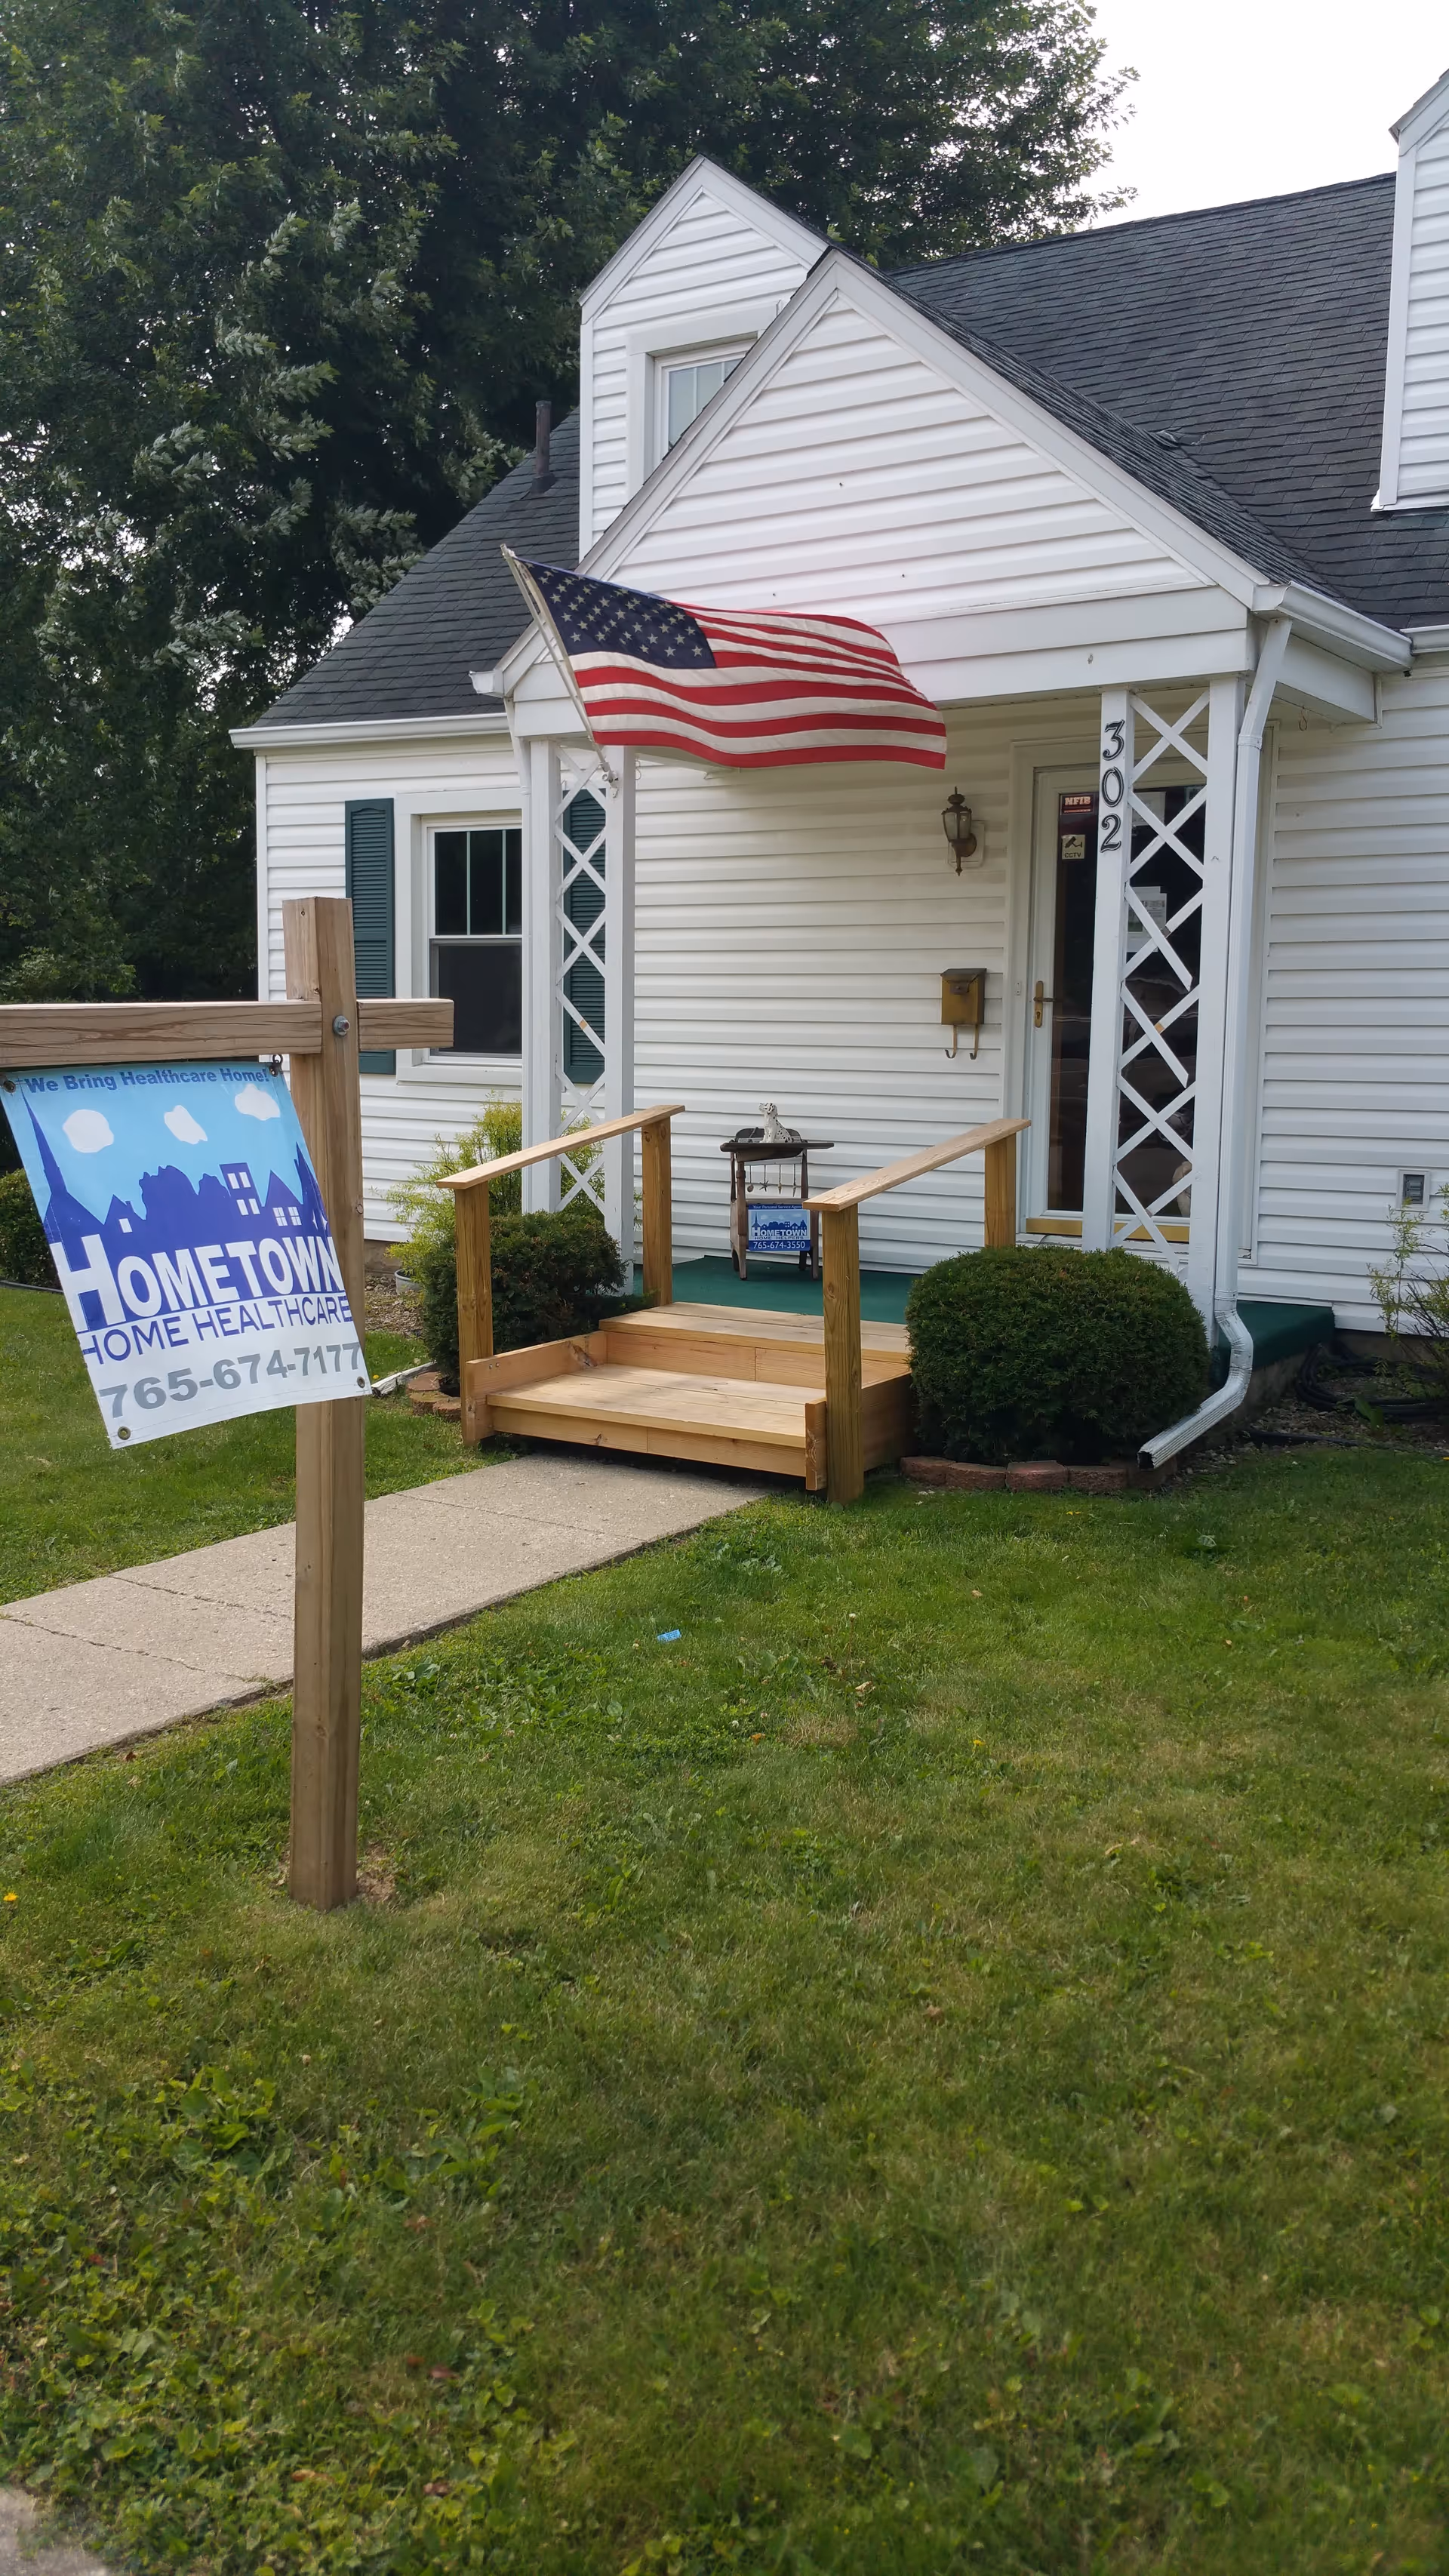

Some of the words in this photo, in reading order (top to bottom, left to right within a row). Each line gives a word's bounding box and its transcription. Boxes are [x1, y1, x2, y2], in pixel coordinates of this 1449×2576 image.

[1064, 796, 1091, 806] NFIB
[1100, 719, 1125, 853] 302
[25, 1077, 59, 1094] We
[63, 1075, 118, 1091] Bring
[120, 1069, 218, 1086] Healthcare
[219, 1067, 269, 1083] Home!
[752, 1226, 807, 1236] HOMETOWN
[753, 1241, 806, 1249] 765-674-3550
[50, 1234, 346, 1333] HOMETOWN
[192, 1296, 353, 1341] HEALTHCARE
[99, 1342, 360, 1418] 765-674-7177
